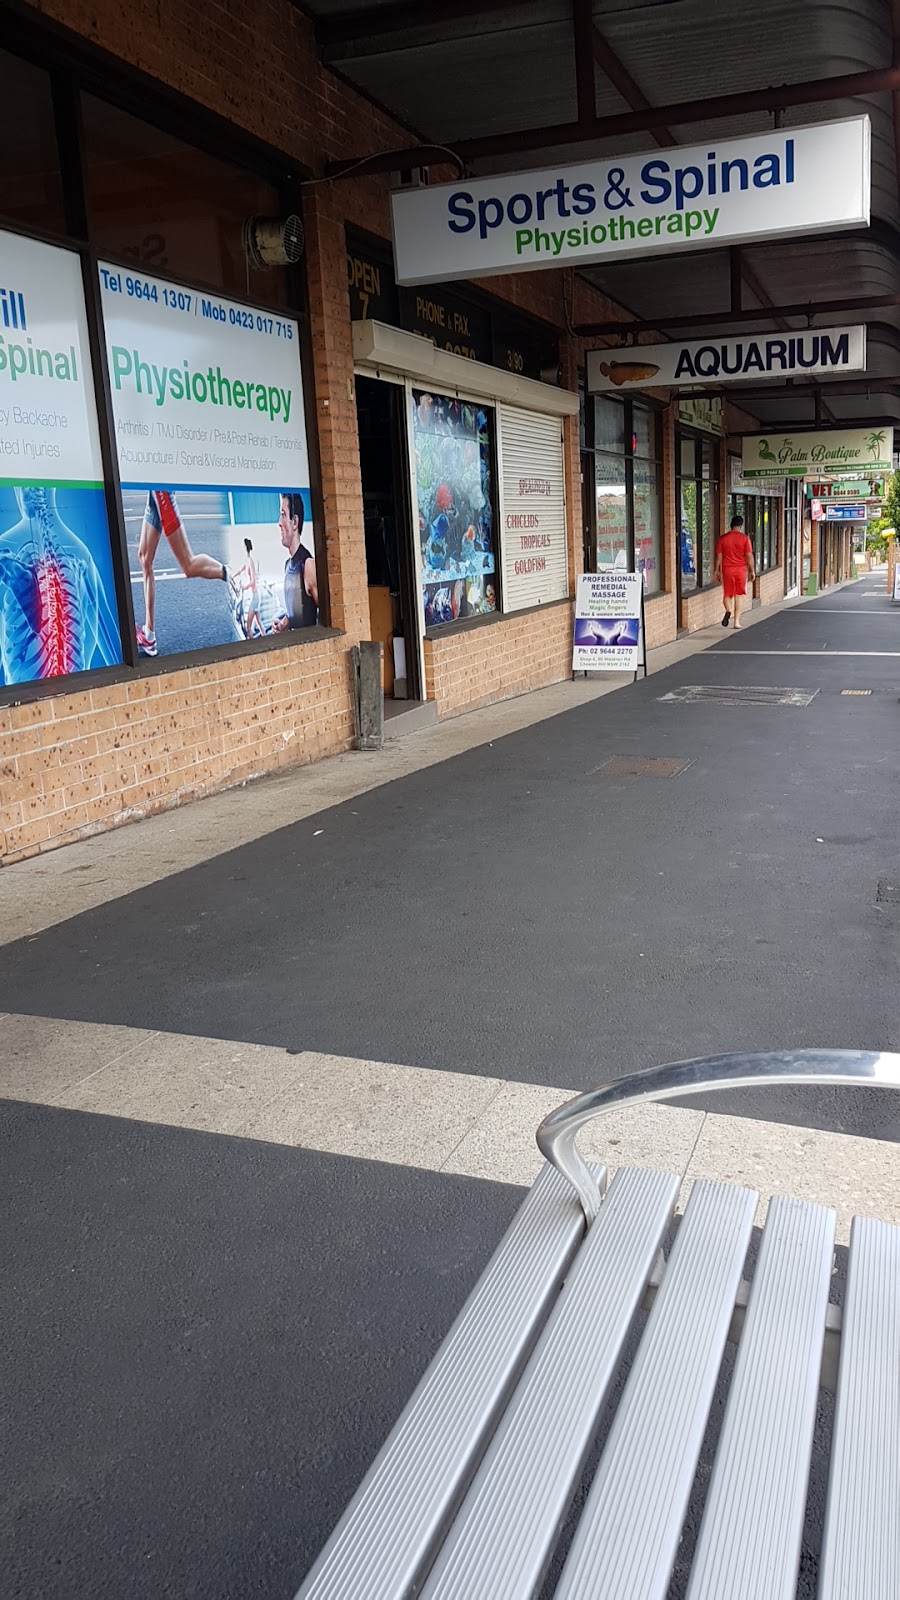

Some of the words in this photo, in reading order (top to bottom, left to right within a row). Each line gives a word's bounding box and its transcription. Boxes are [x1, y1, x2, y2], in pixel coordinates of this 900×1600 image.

[640, 139, 795, 211] Spinal
[514, 207, 720, 256] Physiotherapy
[347, 255, 381, 296] OPEN
[100, 269, 122, 293] Tel
[126, 277, 158, 303] 9644
[163, 288, 192, 312] 1307
[201, 299, 226, 322] Mob
[229, 308, 254, 330] 0423
[257, 316, 273, 334] 017
[276, 321, 293, 340] 715
[416, 297, 445, 327] PHONE
[674, 333, 849, 379] AQUARIUM
[111, 345, 292, 424] Physiotherapy
[13, 406, 69, 429] Backache
[117, 418, 149, 437] Arthritis
[156, 422, 175, 439] TMJ
[176, 424, 208, 442] Disorder
[248, 433, 269, 448] Rehab
[22, 439, 61, 460] Injuries
[120, 447, 174, 467] Acupuncture
[237, 455, 277, 472] Manipulation
[778, 446, 808, 464] Palm
[811, 444, 861, 462] Boutique
[811, 483, 834, 497] VET
[519, 534, 551, 550] TROPICALS
[514, 557, 546, 575] GOLDFISH
[582, 575, 637, 583] PROFESSIONAL
[591, 583, 628, 591] REMEDIAL
[617, 647, 633, 655] 2270
